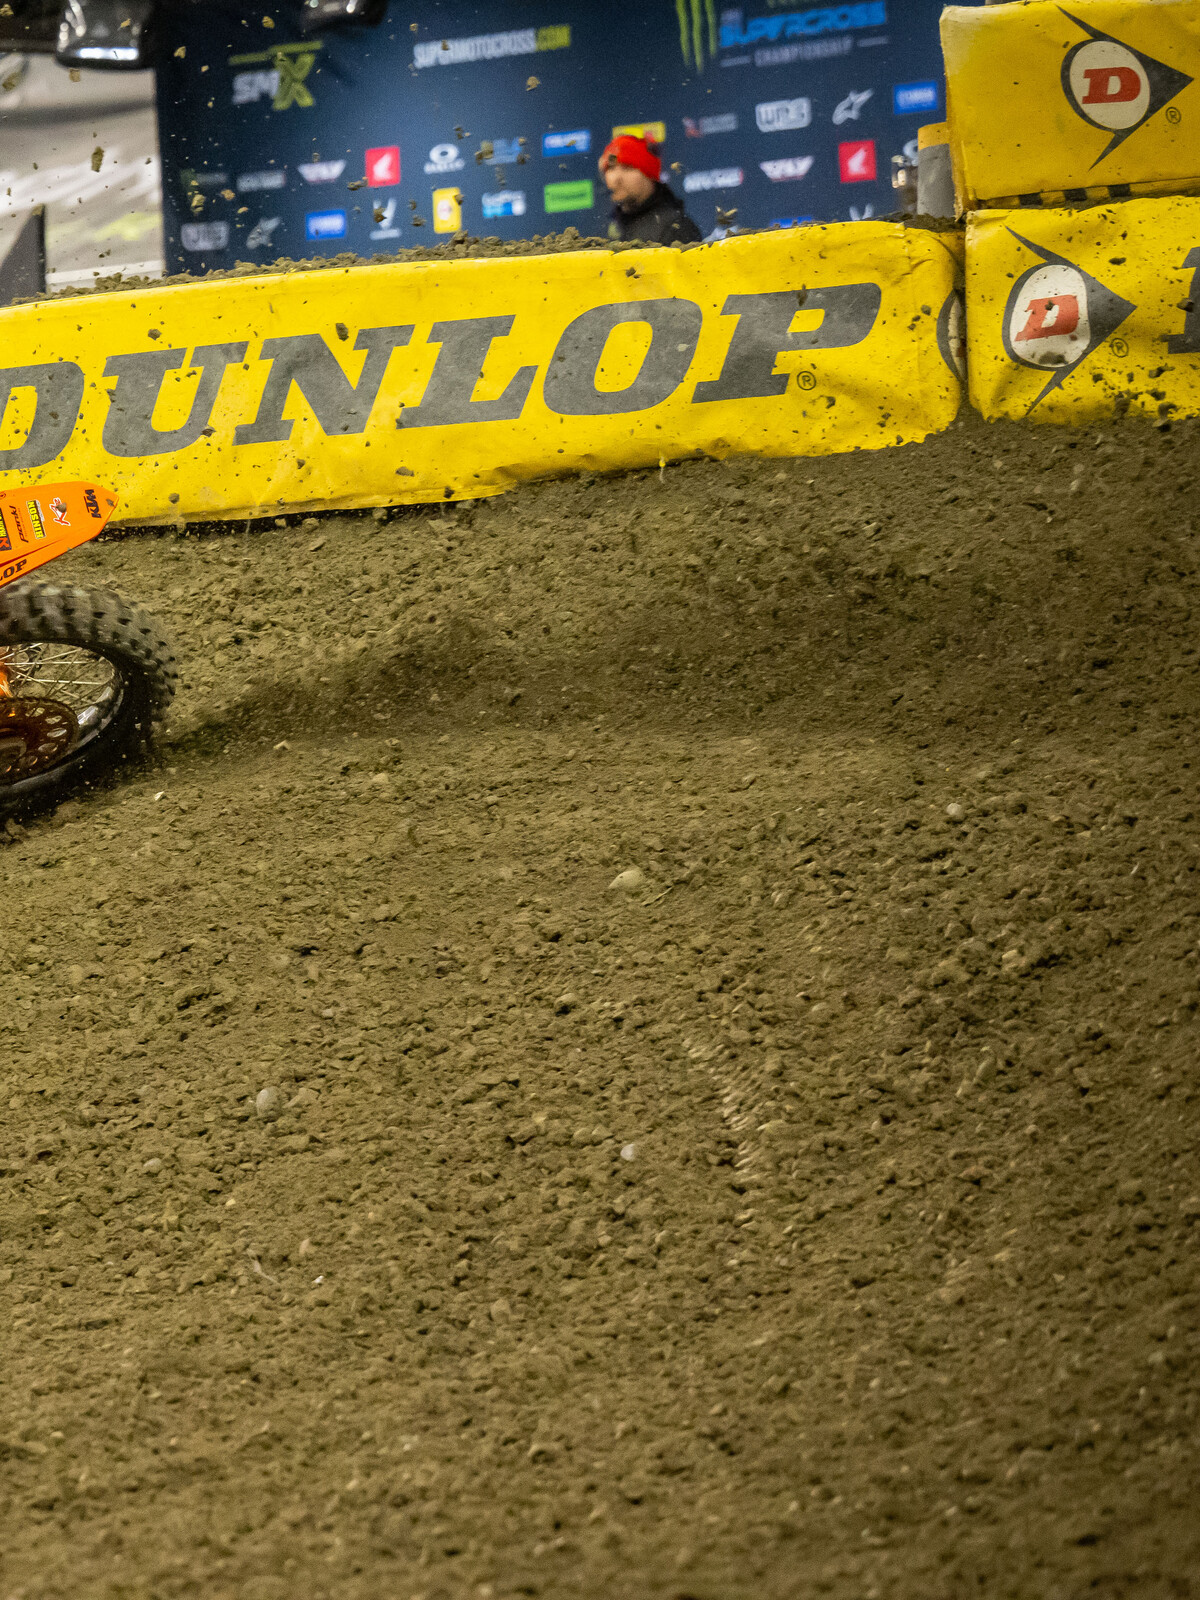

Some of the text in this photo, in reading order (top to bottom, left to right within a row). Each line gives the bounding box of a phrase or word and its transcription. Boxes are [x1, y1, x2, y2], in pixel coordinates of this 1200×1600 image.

[1082, 67, 1141, 104] D
[1015, 294, 1079, 342] D
[27, 501, 45, 538] HINSON
[83, 489, 102, 519] KTM
